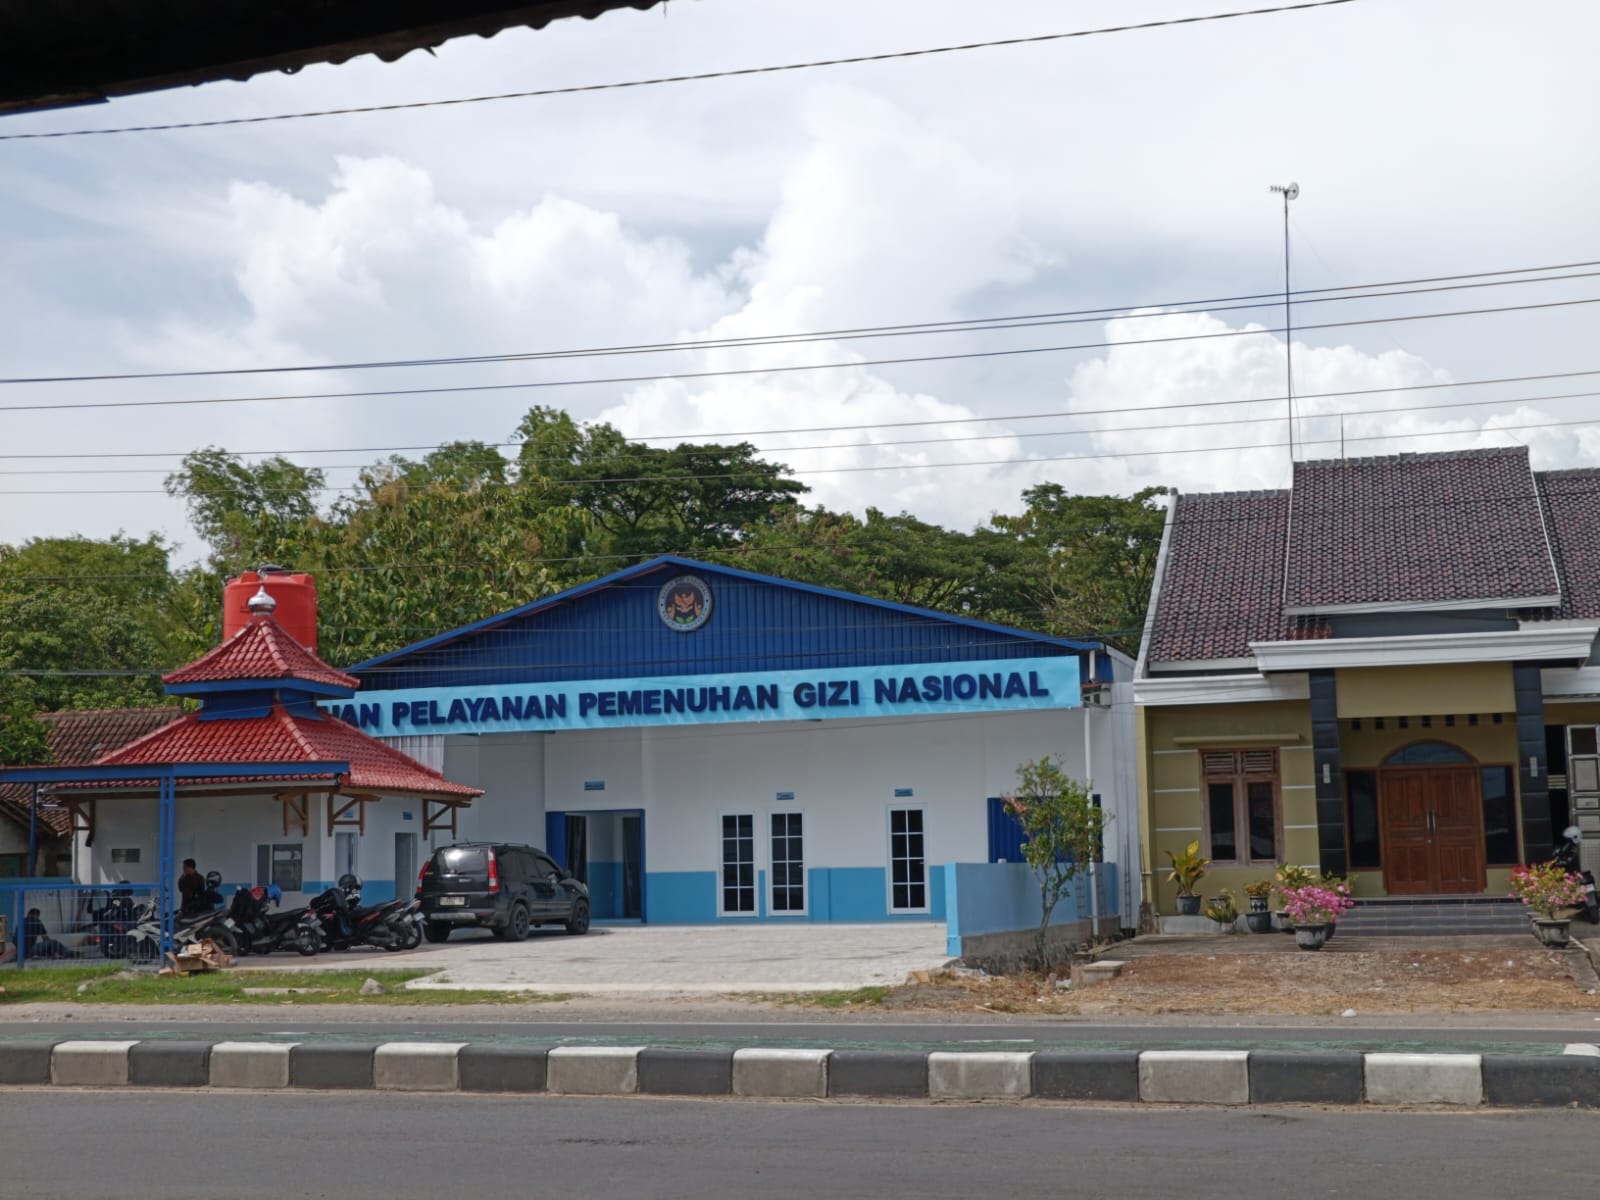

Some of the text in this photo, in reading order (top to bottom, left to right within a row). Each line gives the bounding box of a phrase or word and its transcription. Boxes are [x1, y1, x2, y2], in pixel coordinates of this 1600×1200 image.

[392, 694, 567, 727] PELAYANAN
[579, 685, 778, 717] PEMENUHAN
[794, 681, 859, 708] GIZI
[875, 672, 1048, 704] NASIONAL
